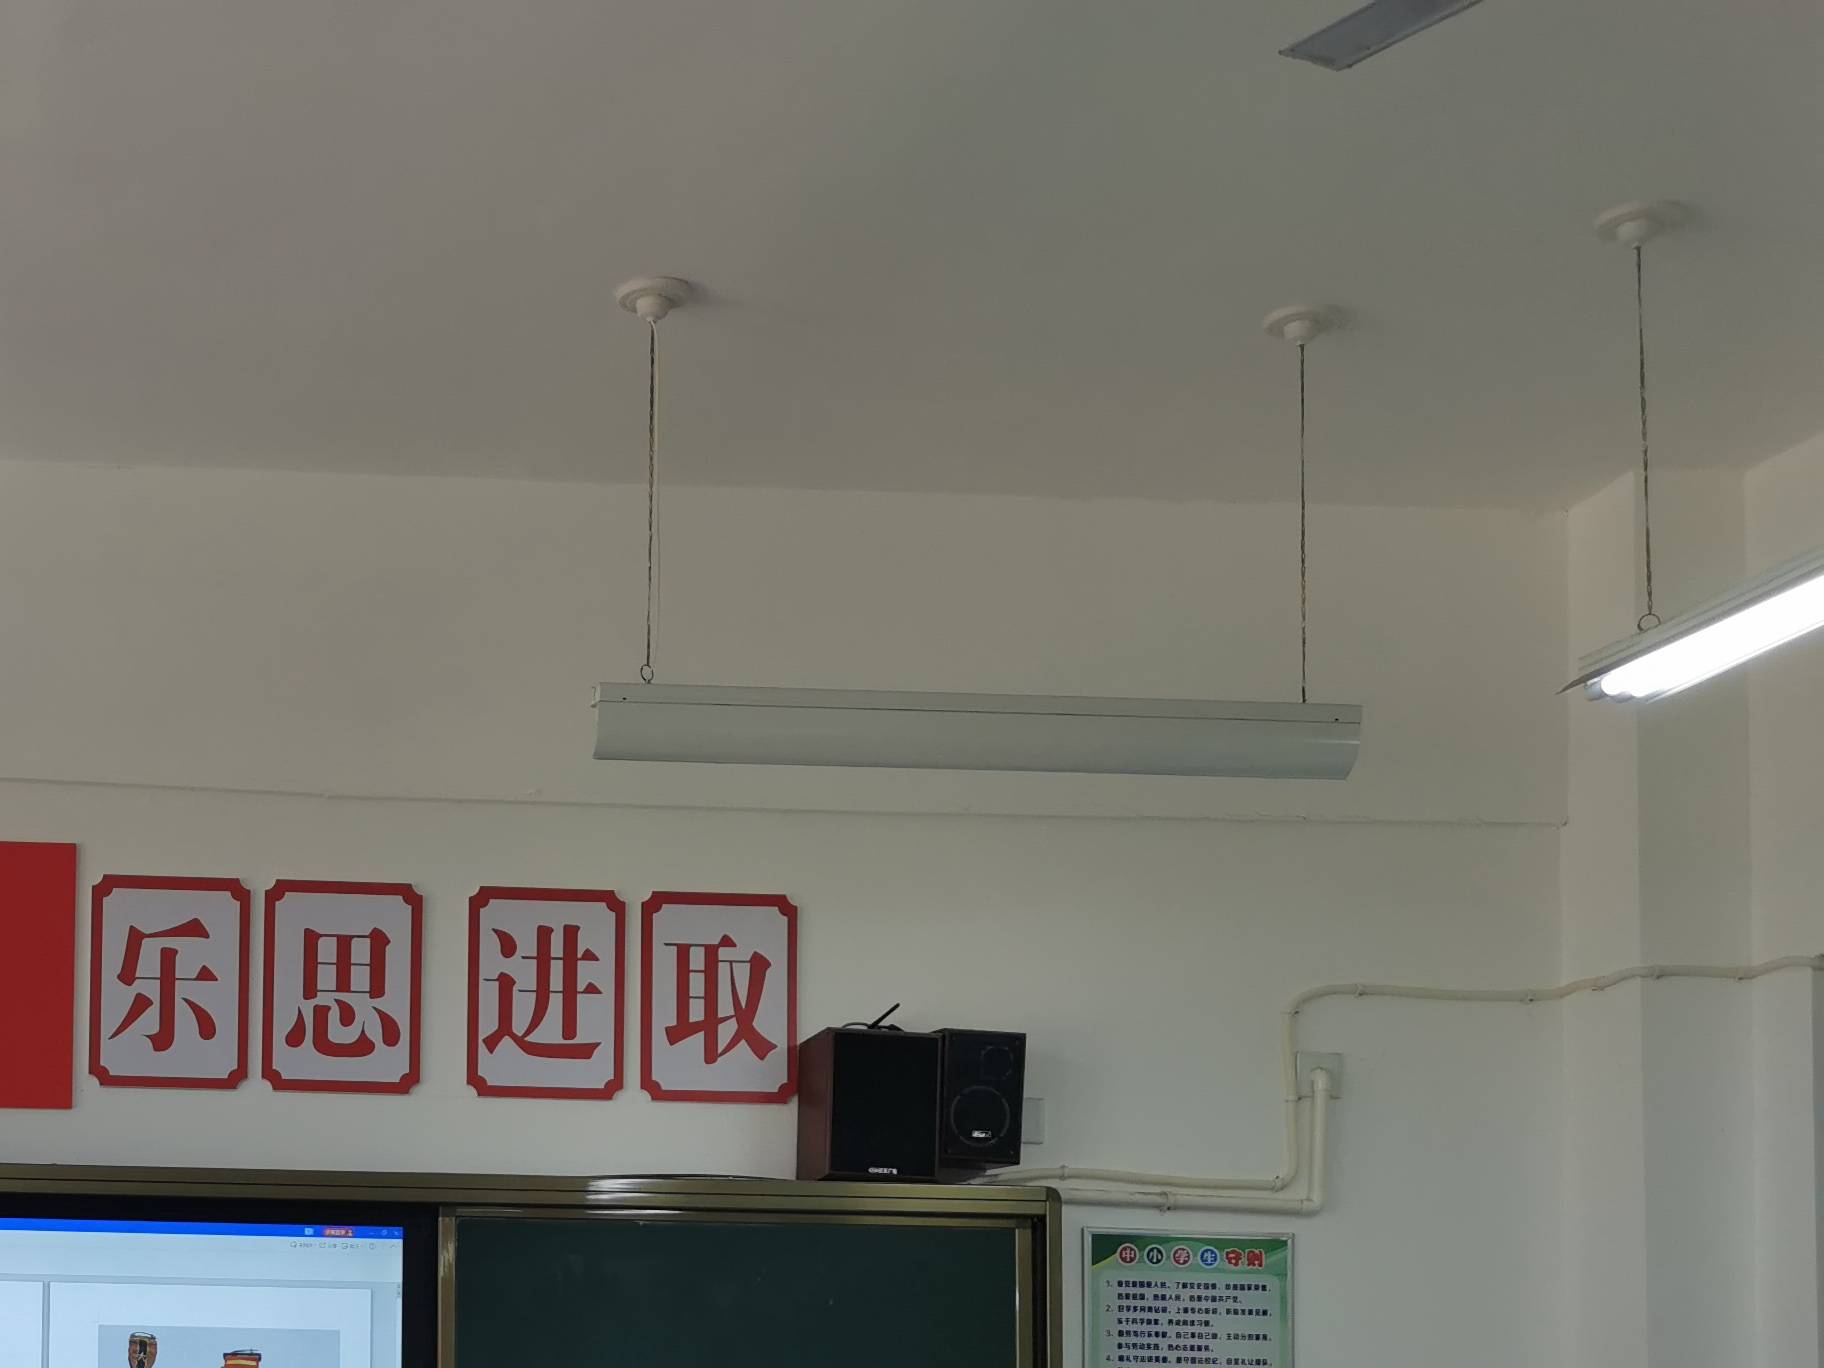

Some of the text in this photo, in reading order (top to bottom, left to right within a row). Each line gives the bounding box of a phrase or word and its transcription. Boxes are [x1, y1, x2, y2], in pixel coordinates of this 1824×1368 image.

[1120, 1247, 1265, 1268] 中小学生守则
